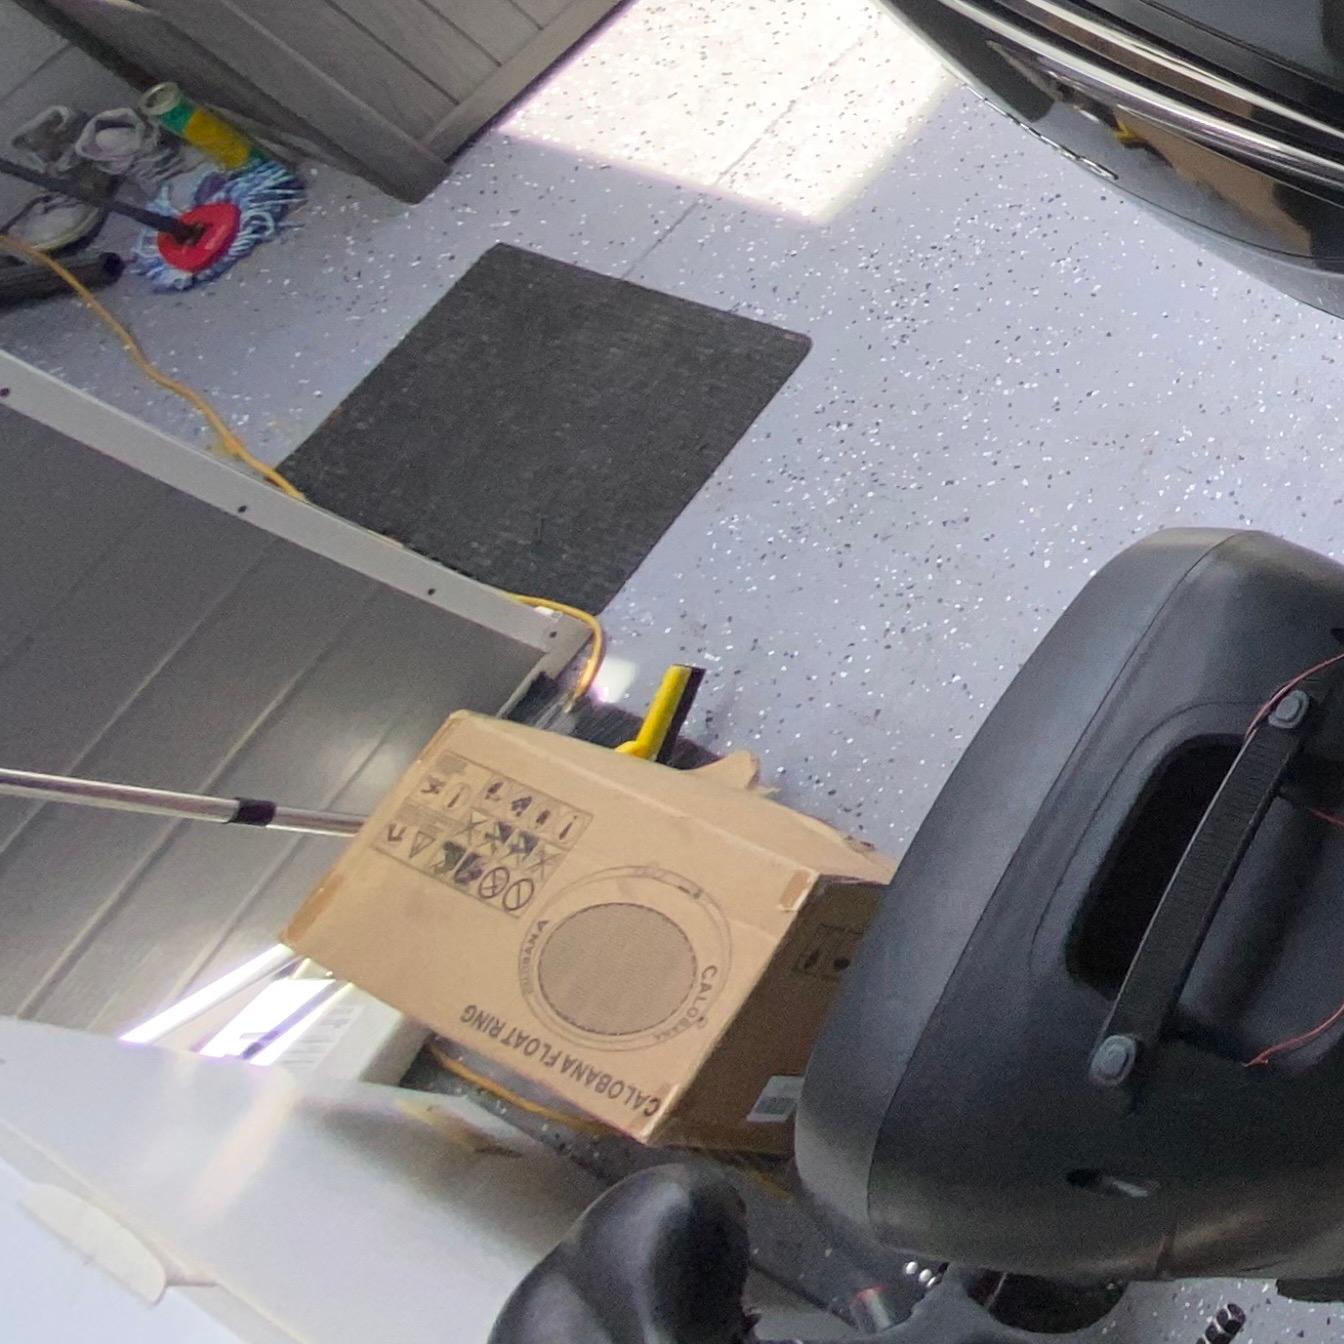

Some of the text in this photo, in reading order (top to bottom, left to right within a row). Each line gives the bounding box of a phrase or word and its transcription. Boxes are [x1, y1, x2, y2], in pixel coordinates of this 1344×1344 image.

[459, 1003, 662, 1117] CALOBANA FLOAT RING
